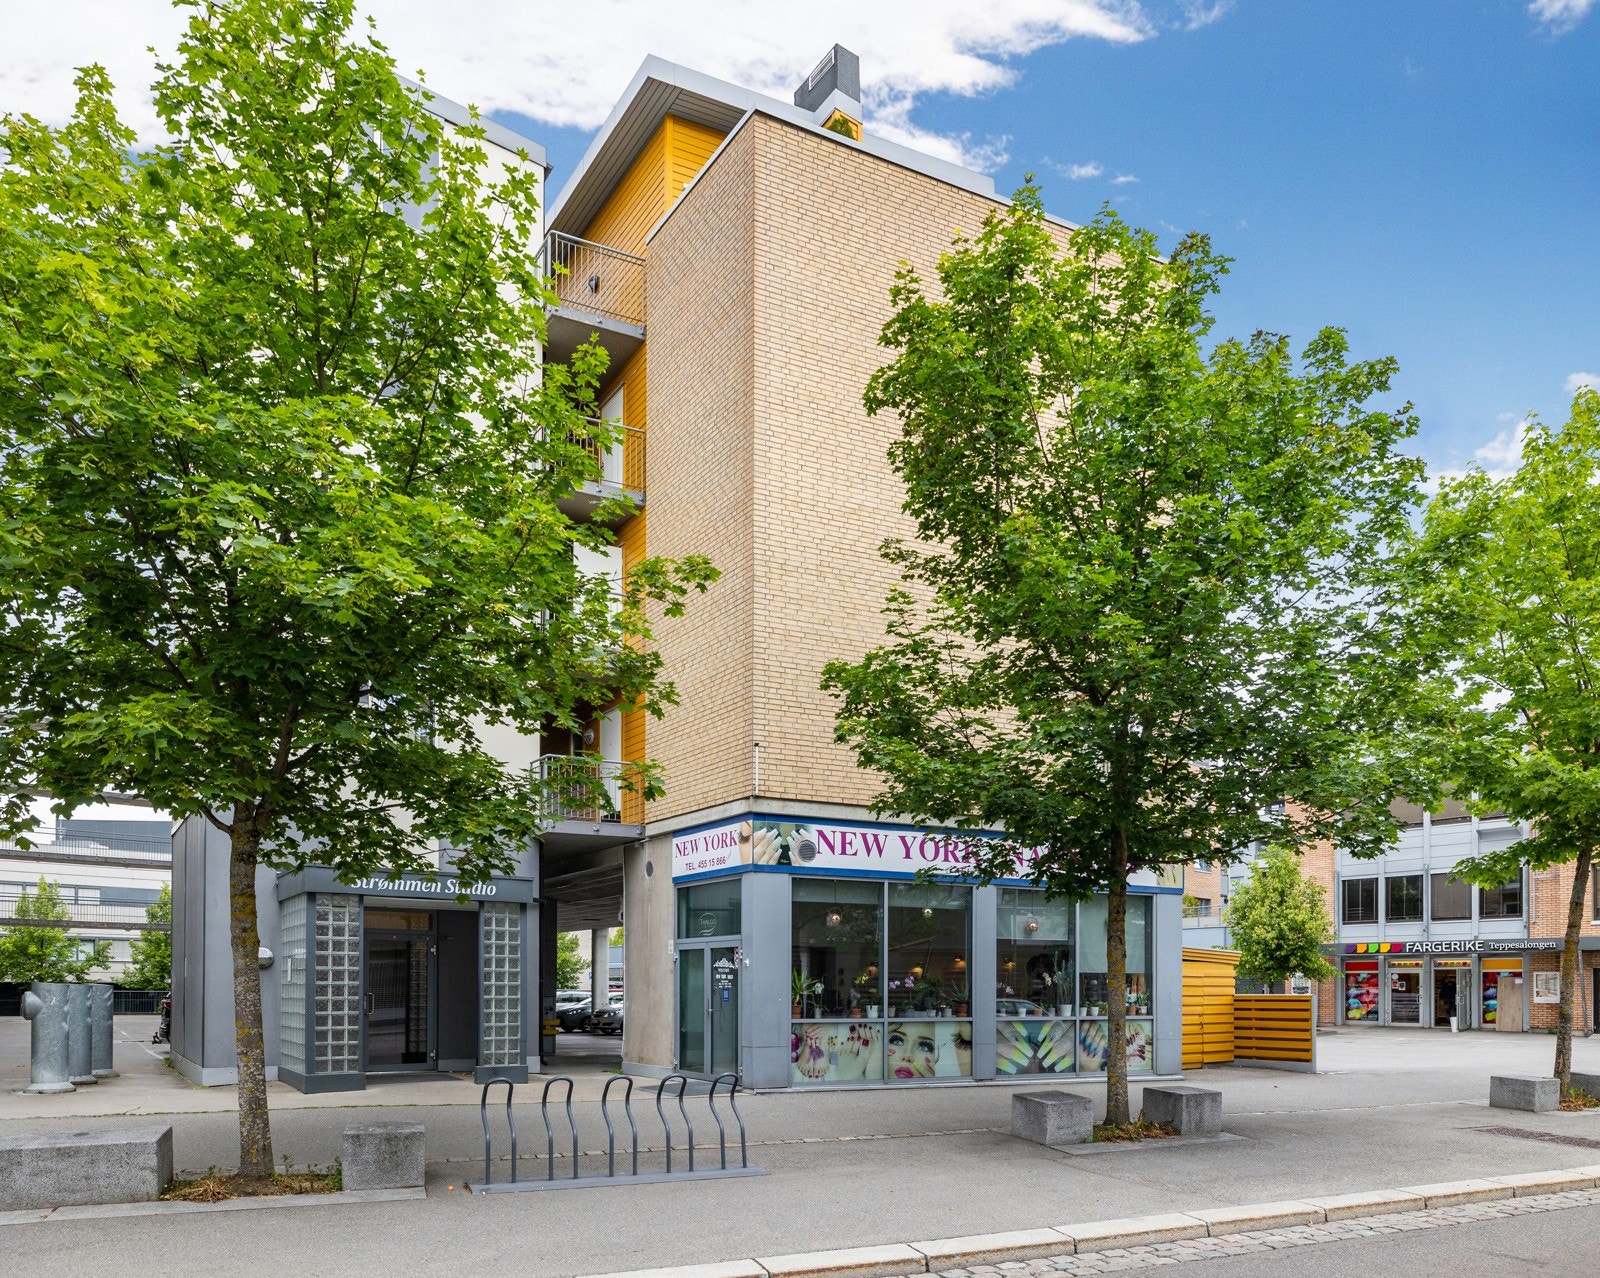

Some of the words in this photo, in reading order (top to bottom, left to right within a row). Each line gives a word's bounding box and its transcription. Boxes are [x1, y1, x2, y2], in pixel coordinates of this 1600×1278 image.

[674, 838, 701, 858] NEW
[703, 829, 738, 852] YORK
[815, 829, 889, 858] NEW
[685, 862, 697, 871] TEL.
[698, 859, 708, 869] 455
[709, 858, 715, 868] 15
[716, 856, 727, 866] 866
[1405, 940, 1485, 953] FARGERIKE
[1488, 940, 1557, 951] Teppesalongen
